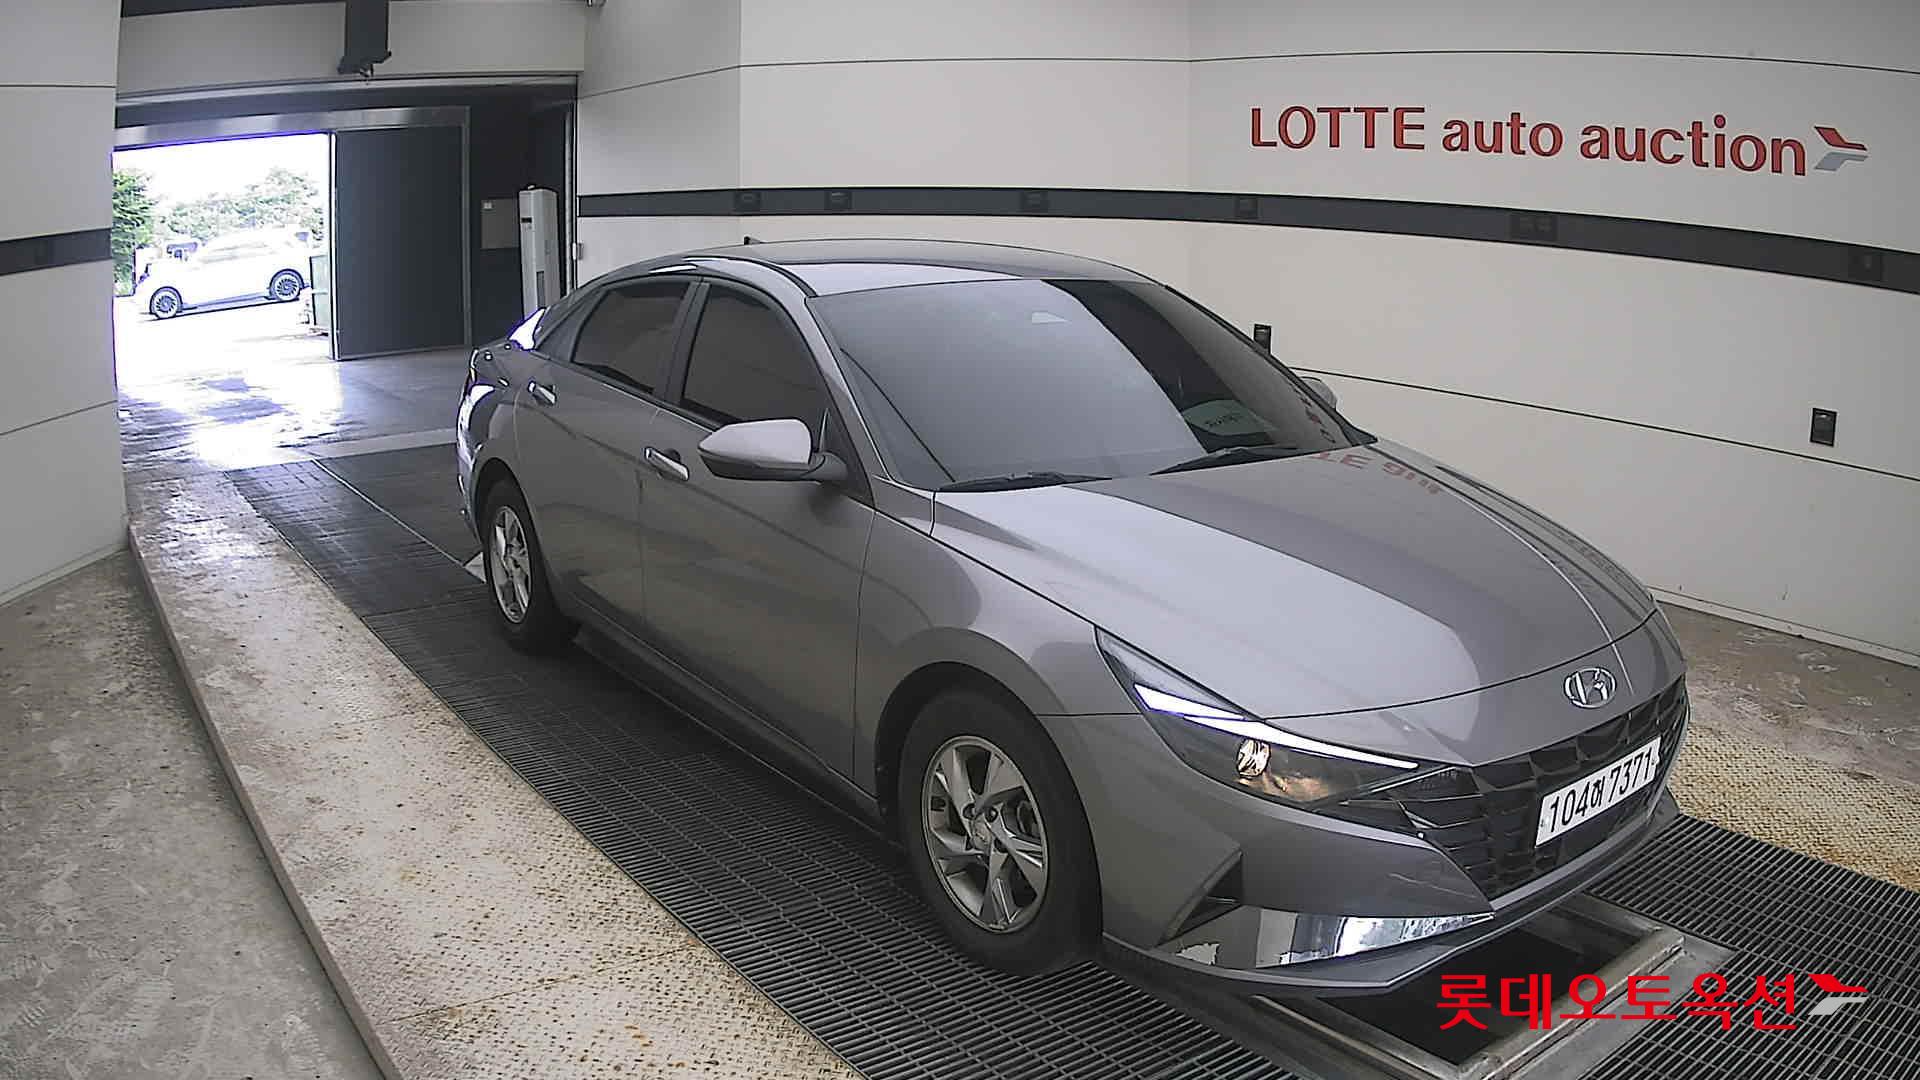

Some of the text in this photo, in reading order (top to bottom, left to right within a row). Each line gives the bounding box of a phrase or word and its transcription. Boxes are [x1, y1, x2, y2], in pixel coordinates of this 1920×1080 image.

[1251, 105, 1806, 177] LOTTE auto auction
[1608, 746, 1653, 803] 7371
